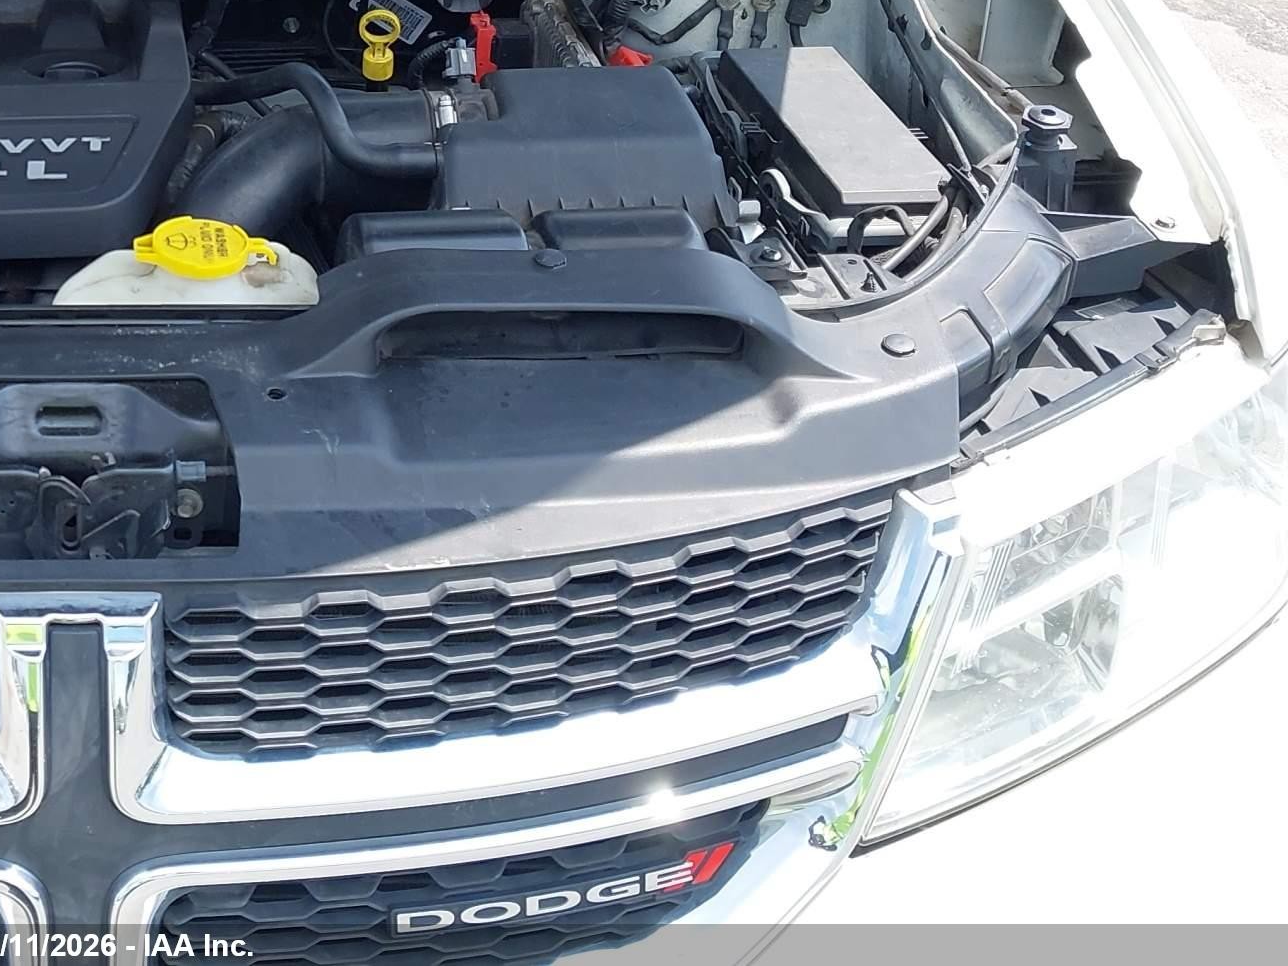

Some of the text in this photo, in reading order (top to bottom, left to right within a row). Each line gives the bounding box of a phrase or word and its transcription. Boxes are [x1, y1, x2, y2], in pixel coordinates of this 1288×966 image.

[0, 136, 111, 154] VVT
[26, 160, 68, 180] L
[214, 227, 229, 258] WASHER
[397, 861, 694, 933] DODGE
